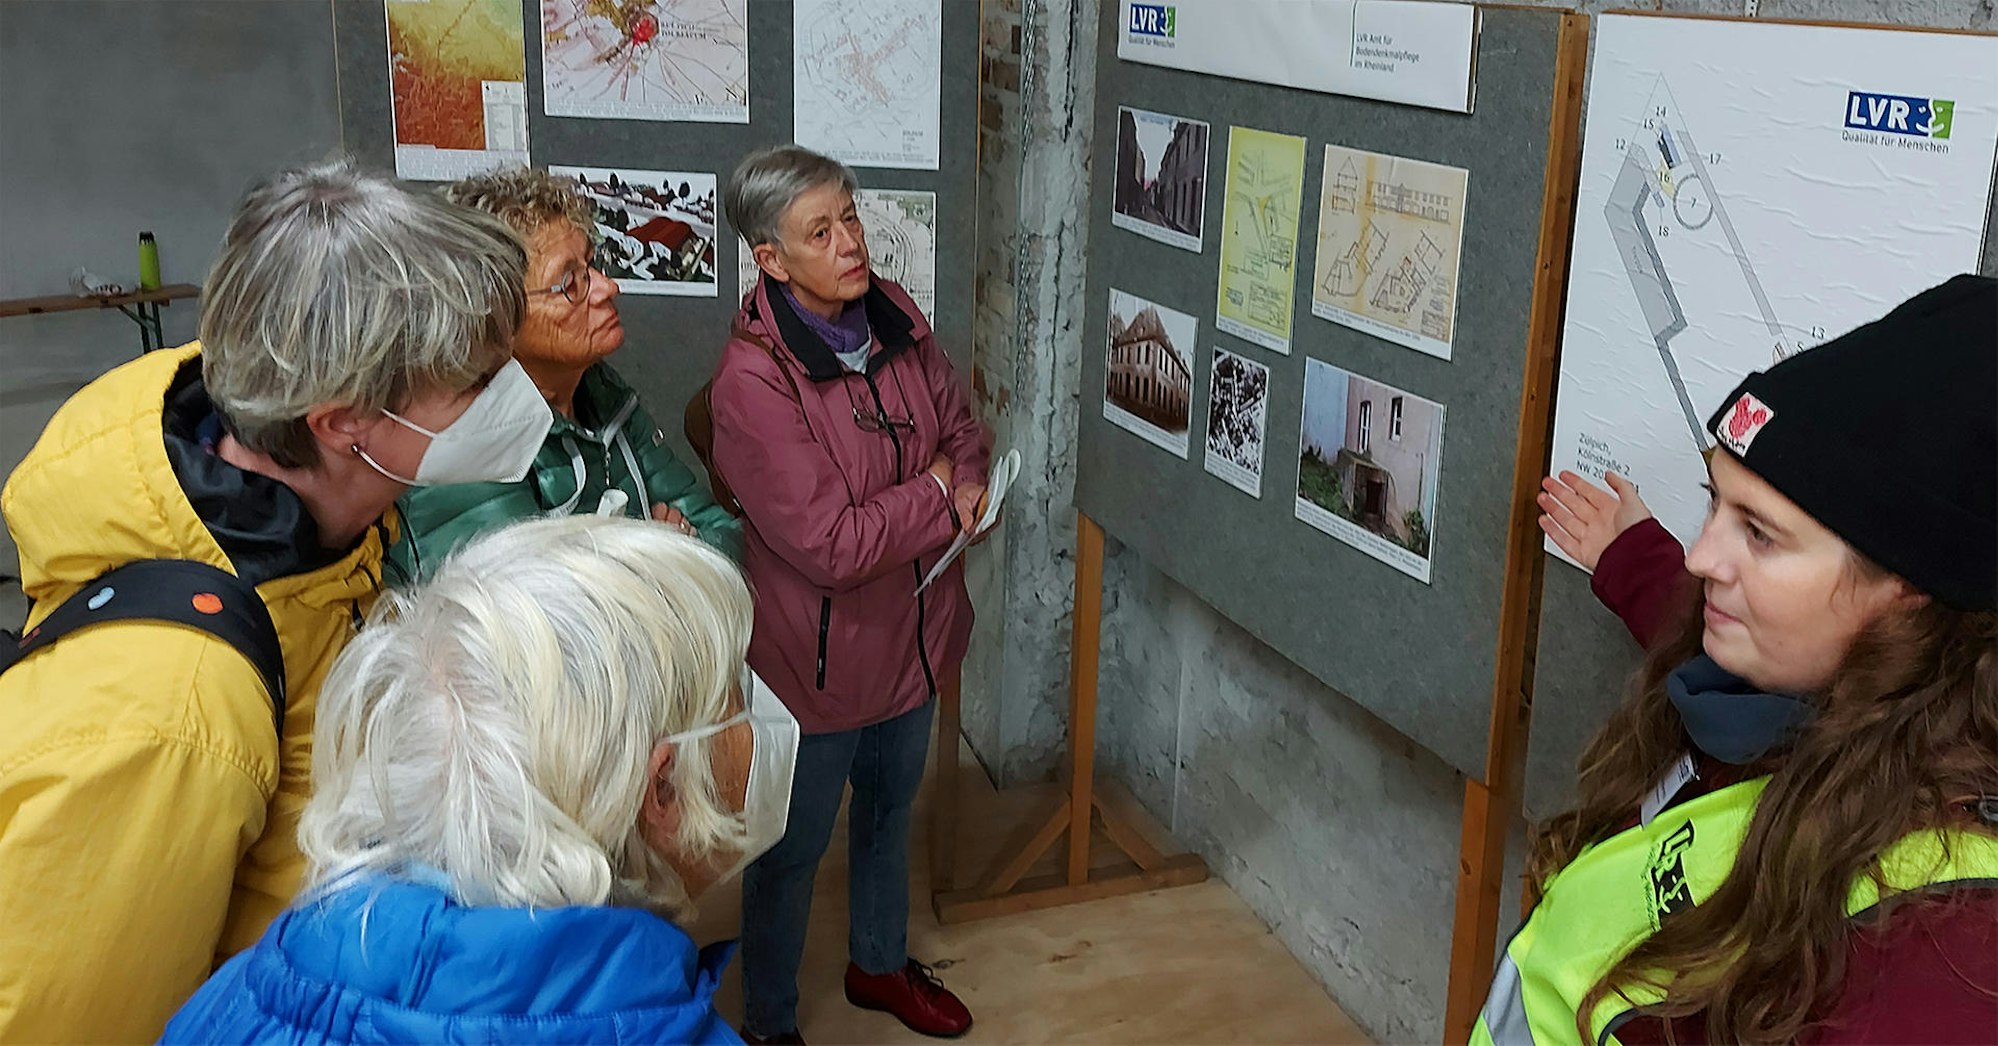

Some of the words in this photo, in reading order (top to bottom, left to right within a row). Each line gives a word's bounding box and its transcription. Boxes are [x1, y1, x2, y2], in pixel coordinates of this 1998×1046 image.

[1132, 6, 1157, 32] LVR
[1656, 106, 1667, 118] 14
[1850, 96, 1909, 130] LVR
[1643, 118, 1655, 130] 15
[1615, 138, 1627, 150] 12
[1841, 130, 1878, 145] Qualität
[1881, 134, 1894, 147] für
[1898, 137, 1950, 155] Menschen
[1709, 152, 1722, 165] 17
[1811, 326, 1826, 340] 13
[1624, 464, 1632, 477] 2
